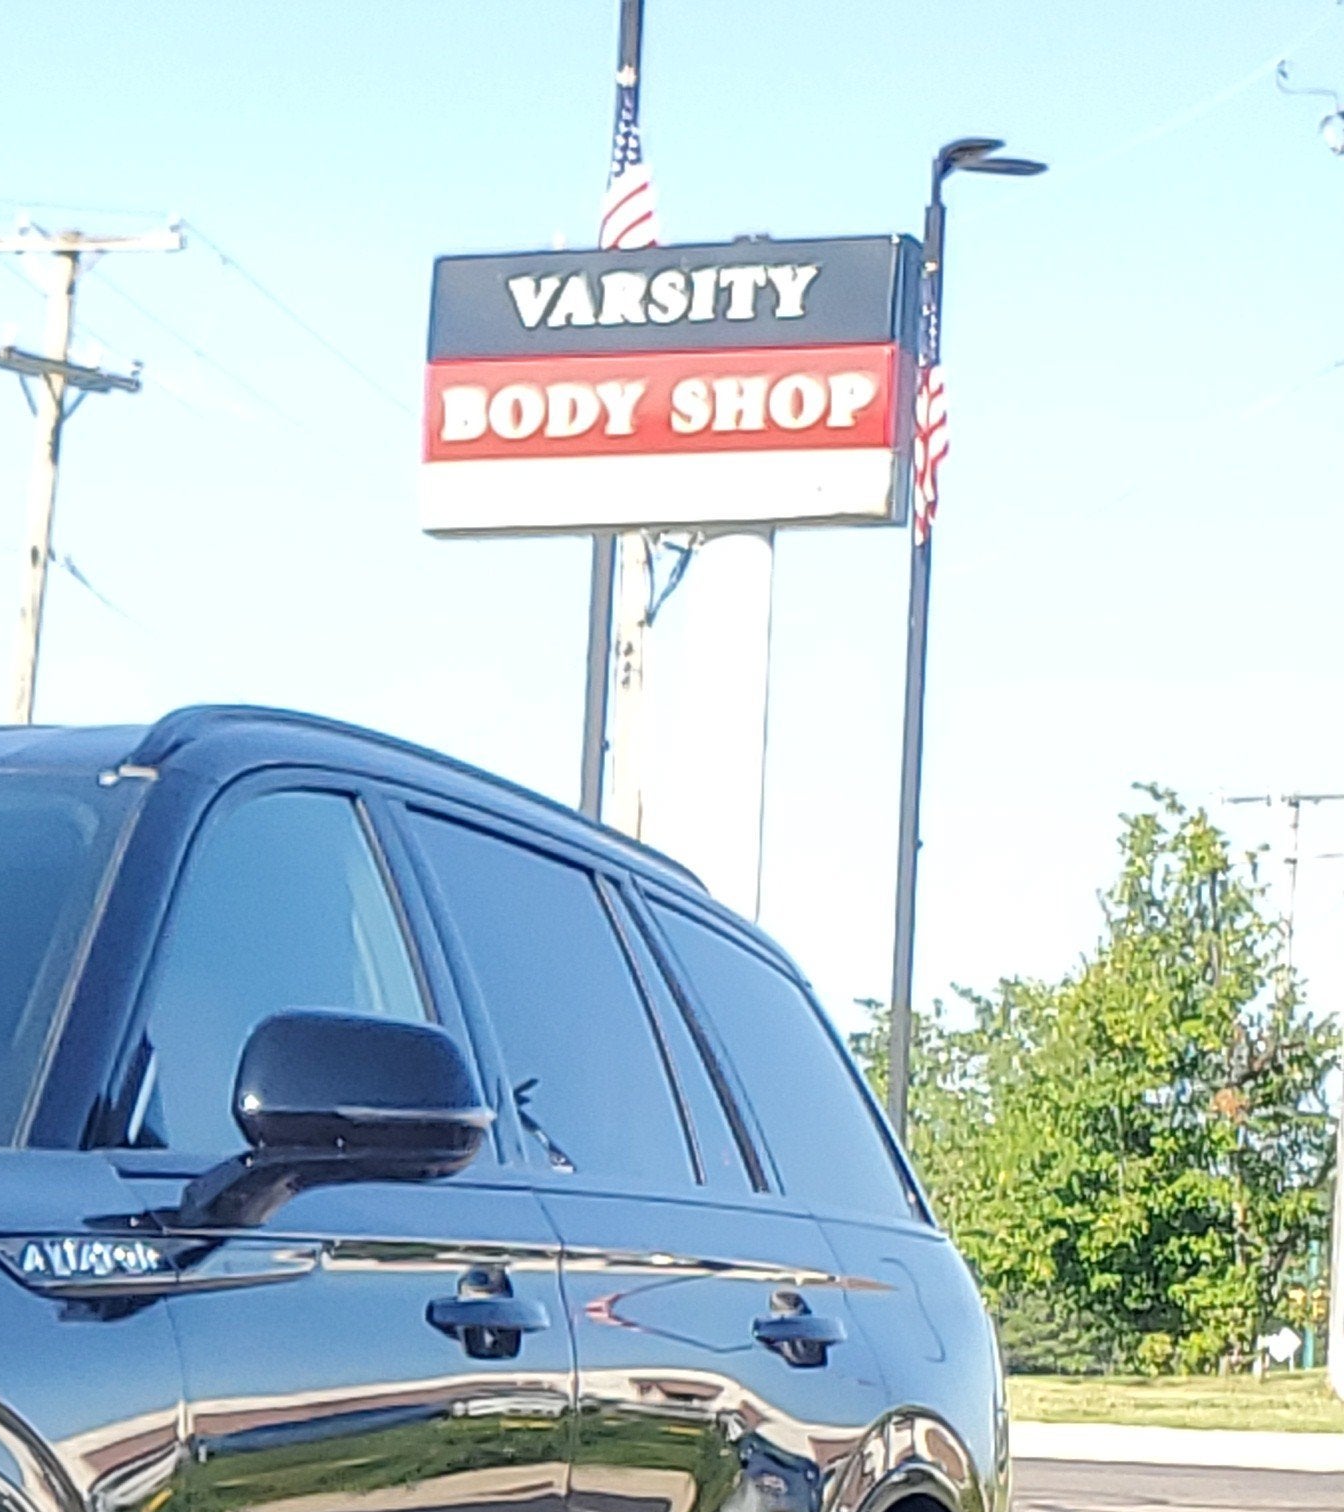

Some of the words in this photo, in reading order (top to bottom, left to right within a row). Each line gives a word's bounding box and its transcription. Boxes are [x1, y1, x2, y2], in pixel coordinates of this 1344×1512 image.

[509, 264, 819, 327] VARSITY
[441, 382, 647, 441] BODY
[670, 373, 878, 434] SHOP
